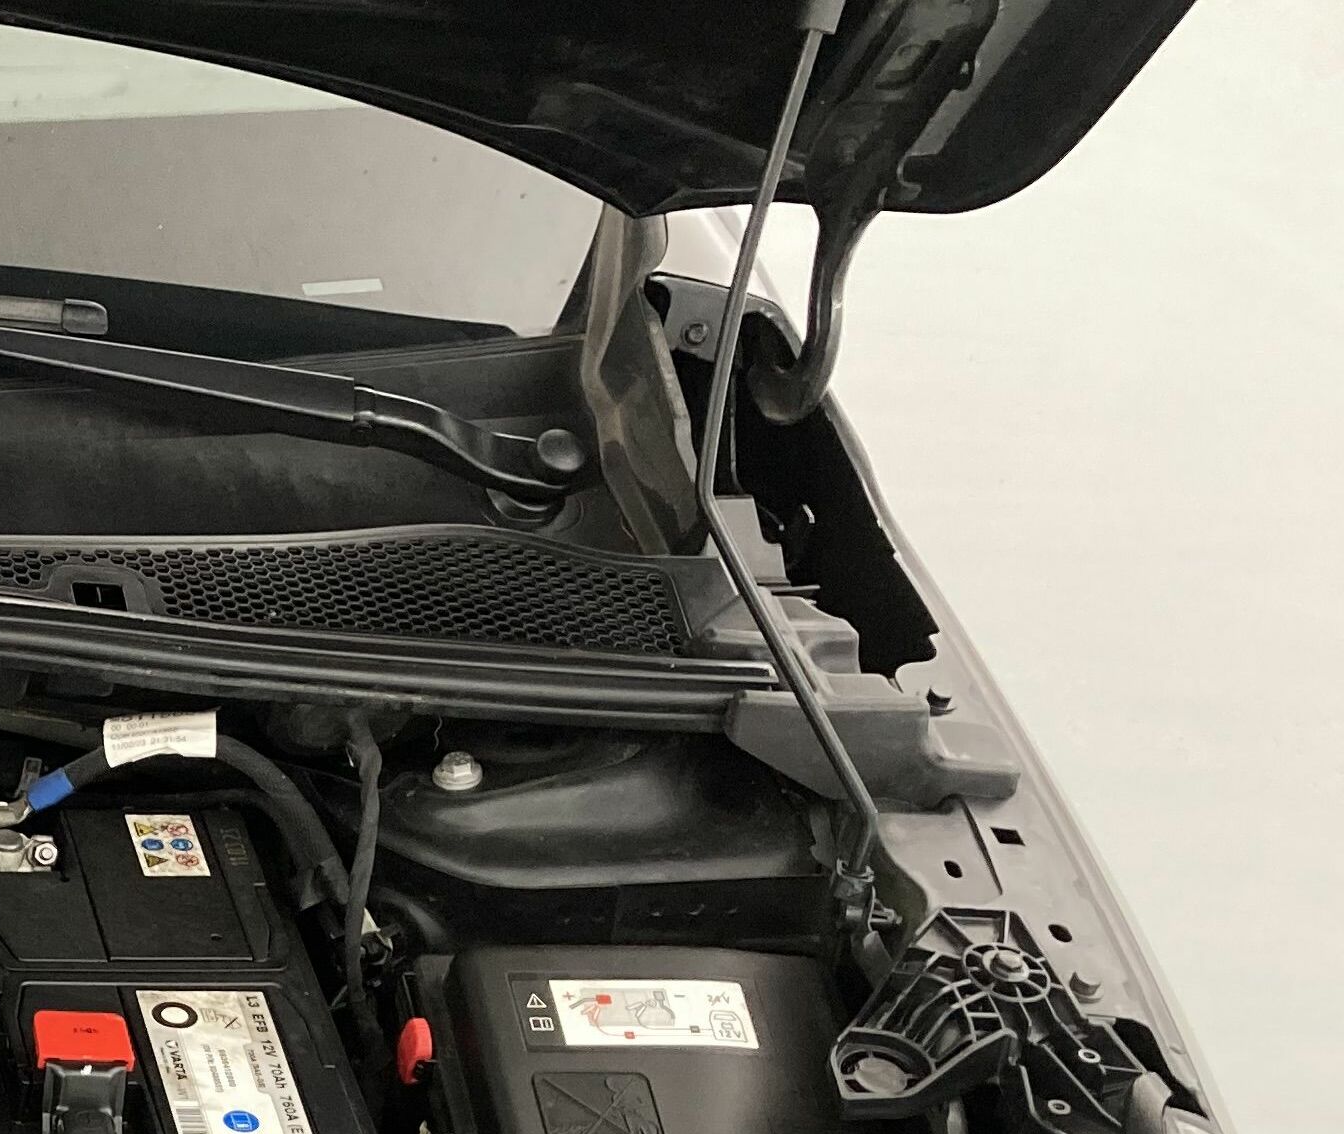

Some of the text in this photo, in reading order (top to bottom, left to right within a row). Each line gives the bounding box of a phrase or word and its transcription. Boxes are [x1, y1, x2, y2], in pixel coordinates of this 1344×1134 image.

[246, 996, 260, 1009] L3
[252, 1013, 269, 1033] EFB
[261, 1039, 278, 1058] 12V
[169, 1050, 188, 1081] VARTA
[269, 1063, 288, 1090] 70Ah
[280, 1095, 300, 1122] 760A
